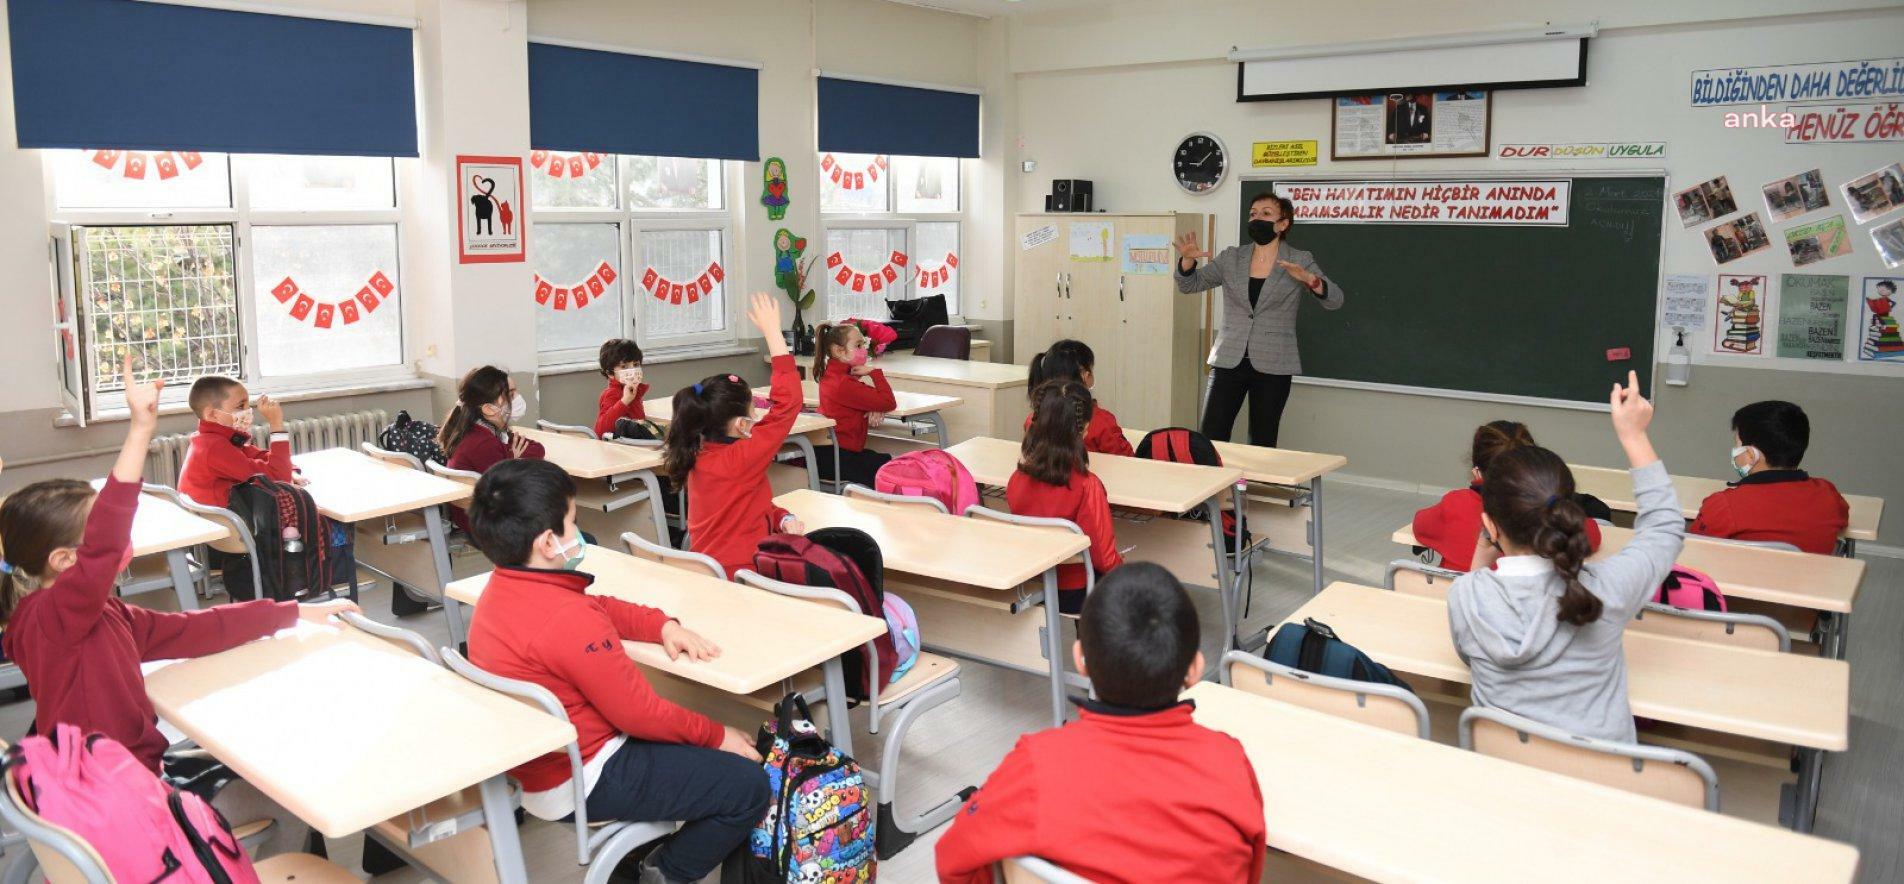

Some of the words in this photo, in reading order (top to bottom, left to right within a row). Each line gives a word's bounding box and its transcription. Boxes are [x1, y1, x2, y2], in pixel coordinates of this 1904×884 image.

[1693, 70, 1788, 104] BİLDİĞİNDEN
[1790, 71, 1831, 100] DAHA
[1787, 107, 1860, 141] HENÜZ
[1499, 147, 1550, 157] DUR
[1609, 144, 1664, 156] UYGULA
[1326, 187, 1416, 201] HAYATIMIN
[1421, 184, 1480, 203] HİÇBİR
[1486, 186, 1556, 201] ANINDA
[1294, 205, 1385, 218] ARAMSARLIK
[1389, 202, 1440, 219] NEDİR
[1786, 276, 1835, 289] OKUMAK
[805, 795, 841, 824] Love
